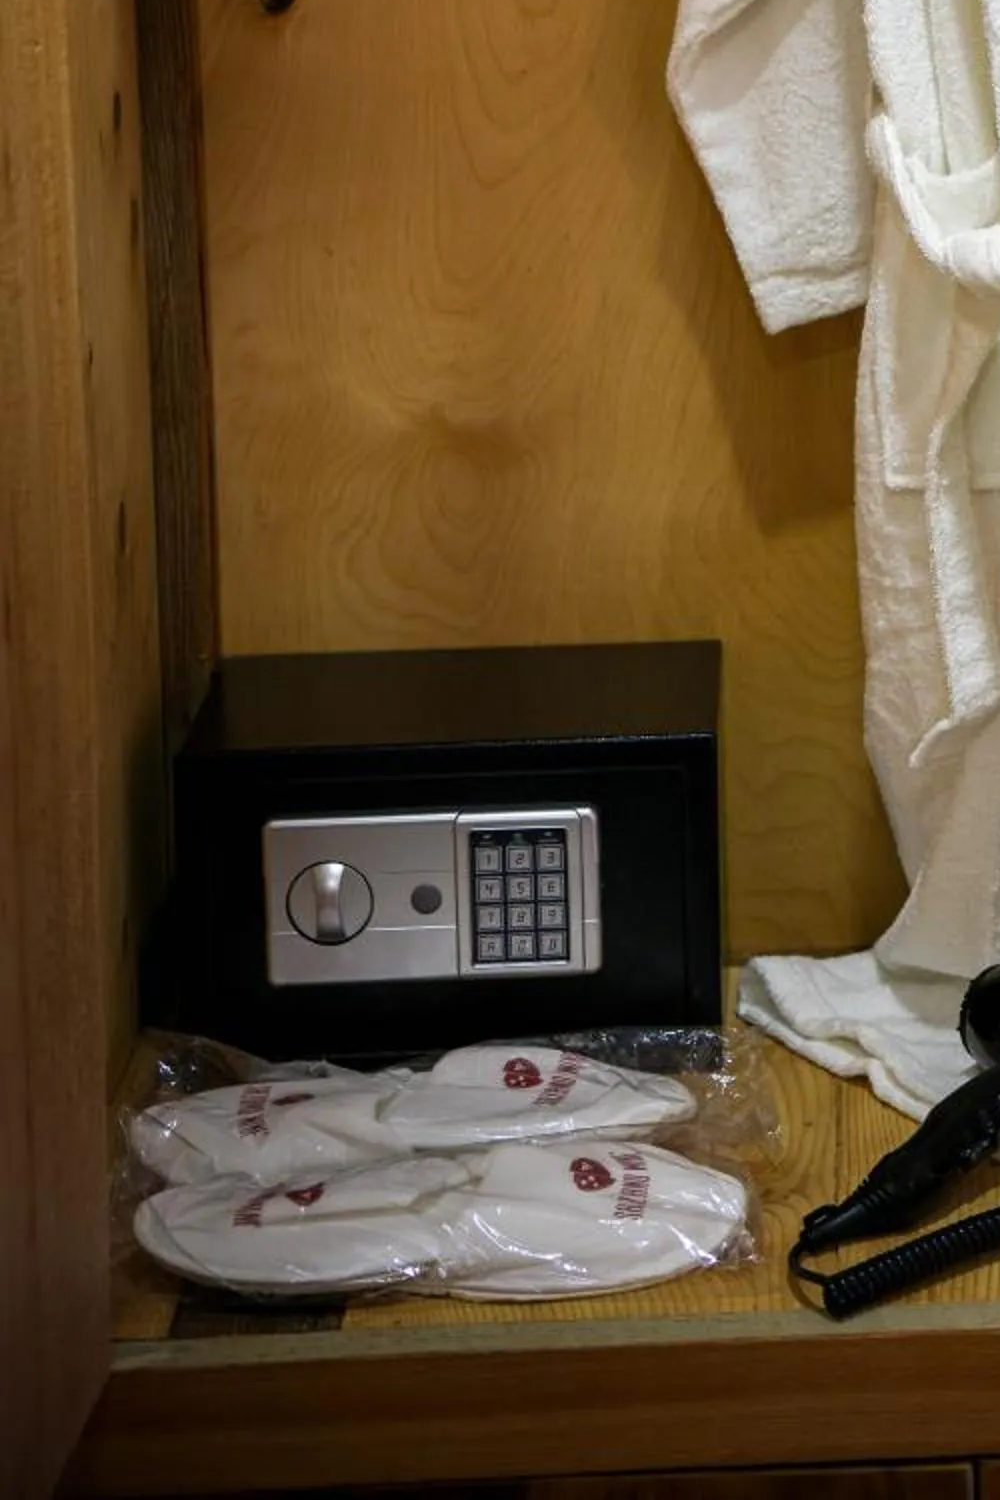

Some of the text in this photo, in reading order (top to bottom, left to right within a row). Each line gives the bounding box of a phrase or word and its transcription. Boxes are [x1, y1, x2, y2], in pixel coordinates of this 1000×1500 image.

[516, 852, 525, 865] 2
[546, 851, 555, 864] 3
[485, 883, 493, 895] 4
[516, 881, 525, 894] 5
